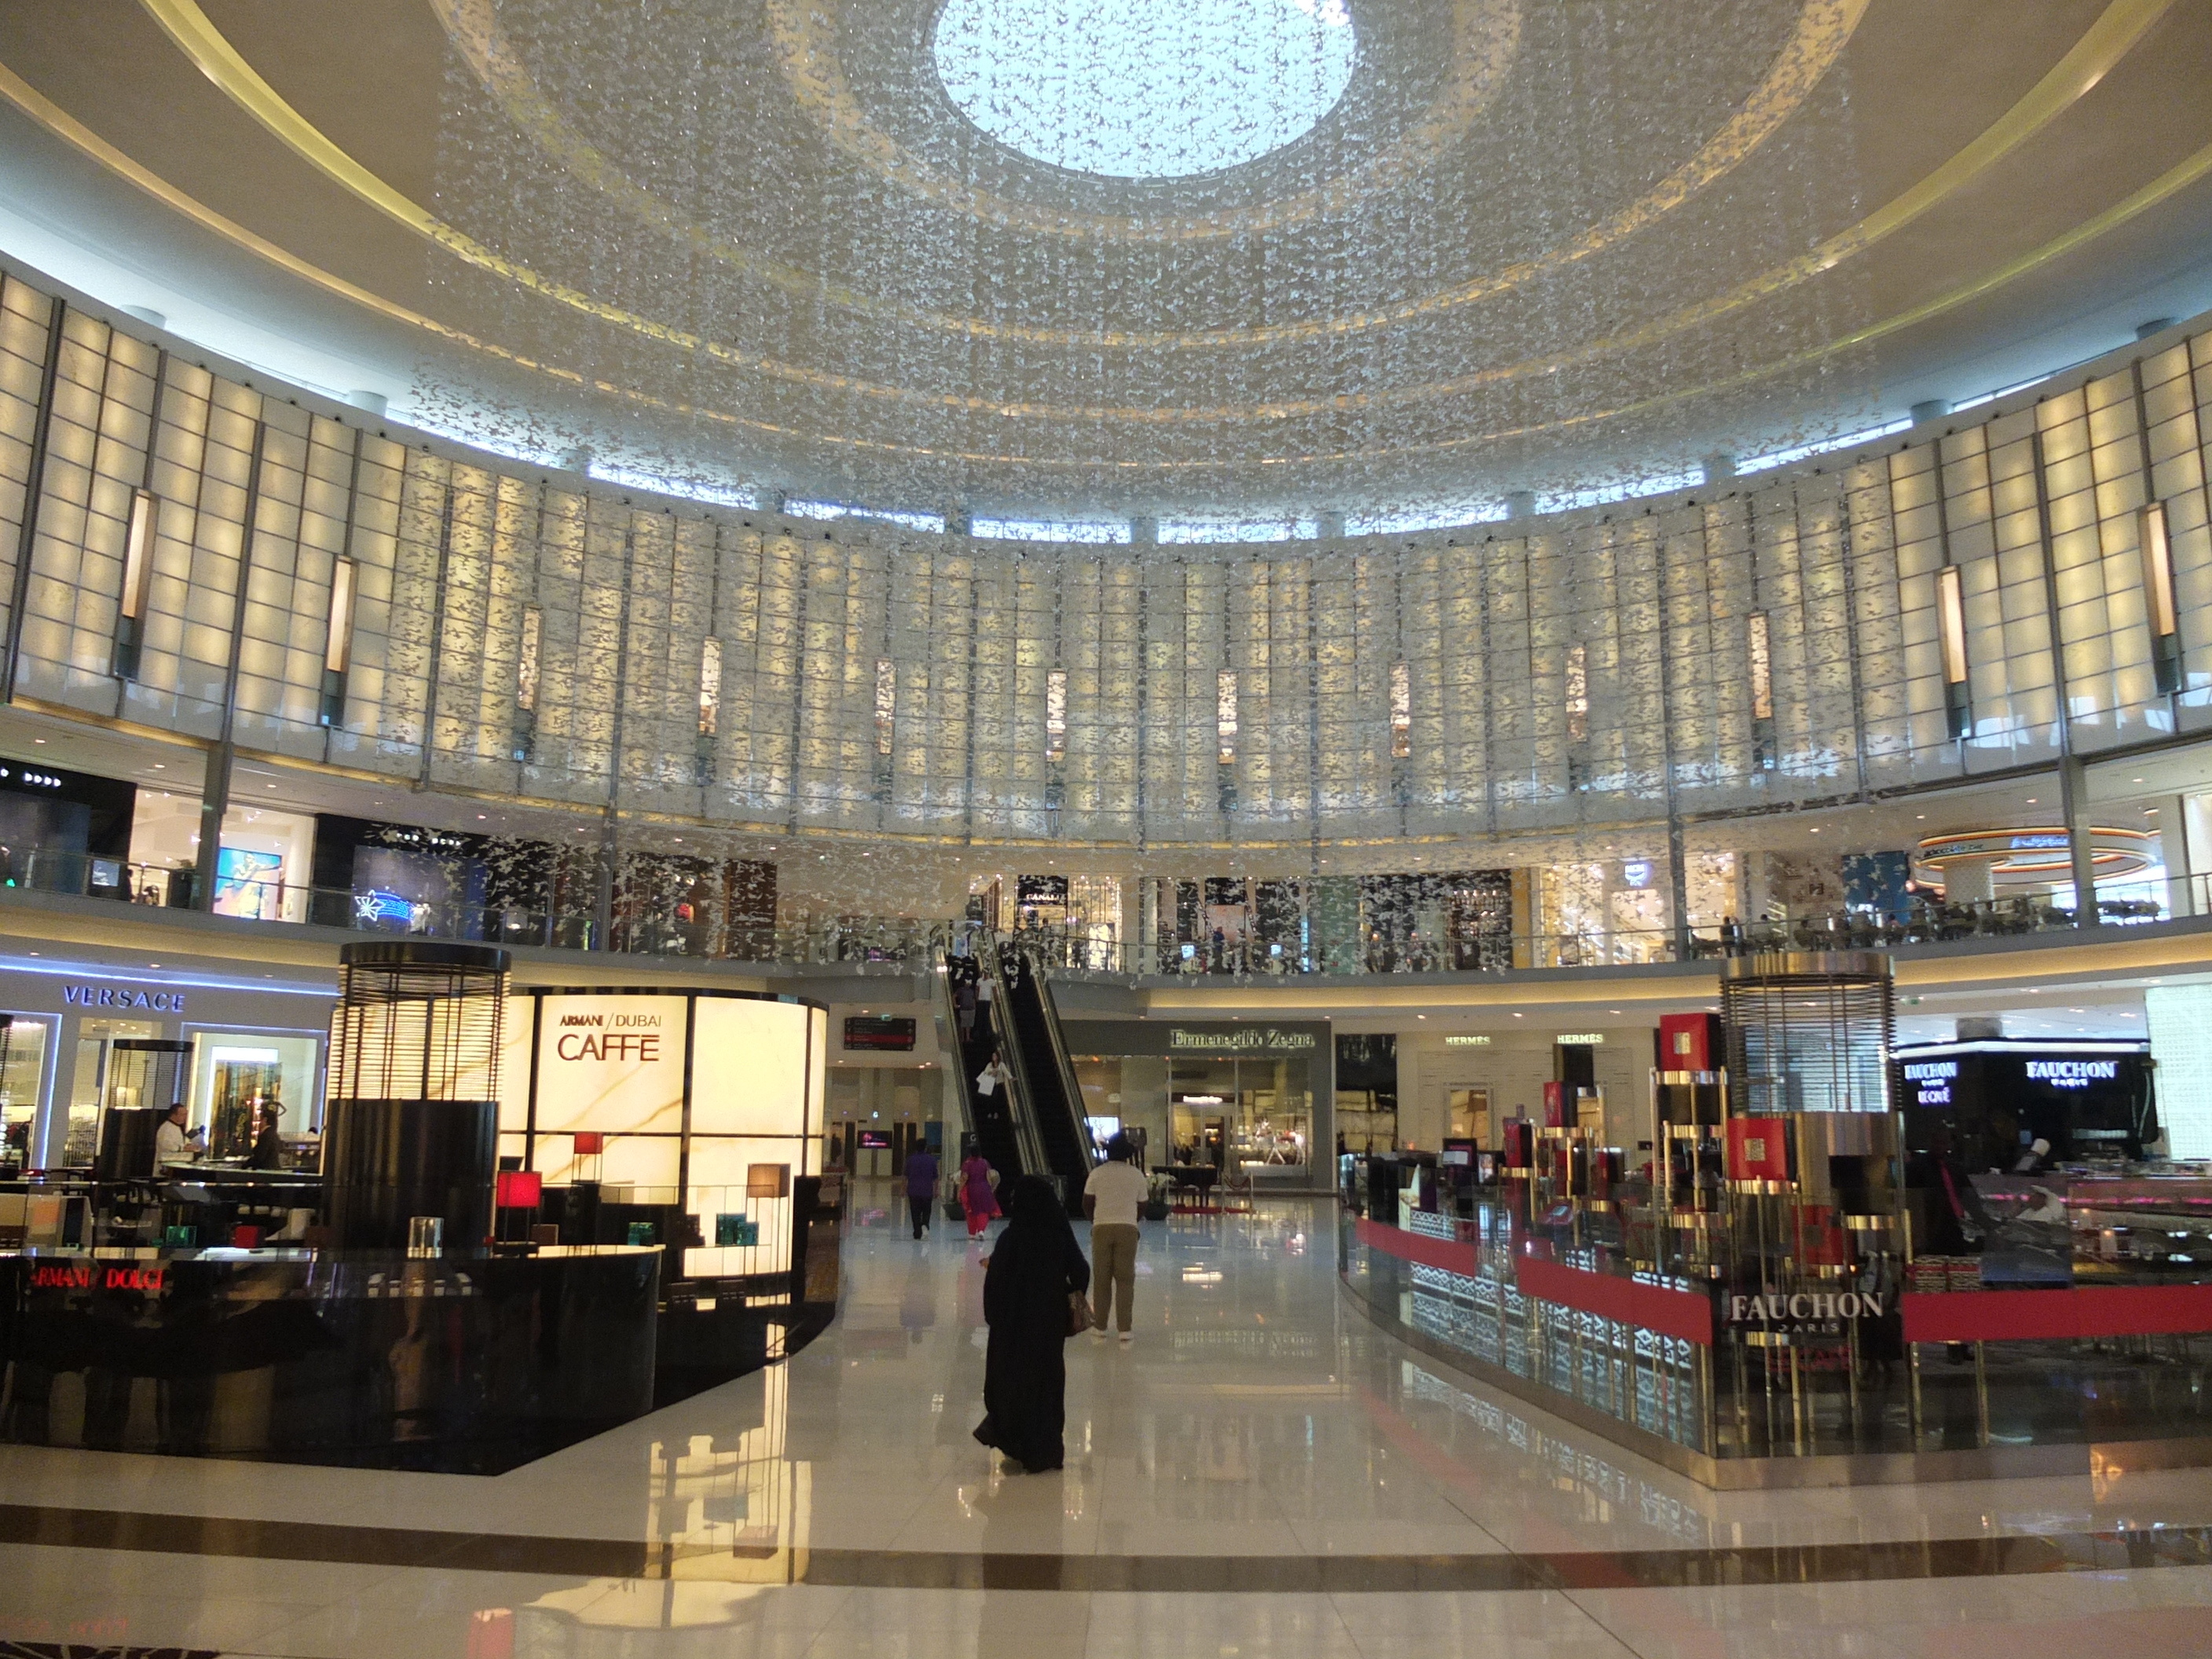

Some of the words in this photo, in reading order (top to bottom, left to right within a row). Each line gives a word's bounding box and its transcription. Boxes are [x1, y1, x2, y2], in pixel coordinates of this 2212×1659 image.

[64, 985, 186, 1013] VERSACE
[559, 1015, 603, 1027] ARMANI
[616, 1015, 661, 1027] DUBAI
[1170, 1029, 1263, 1049] Ermenegildo
[1267, 1029, 1315, 1049] Zegna
[1904, 1062, 1957, 1080] FAUCHON
[2026, 1061, 2115, 1078] FAUCHON
[1730, 1292, 1884, 1320] FAUCHON
